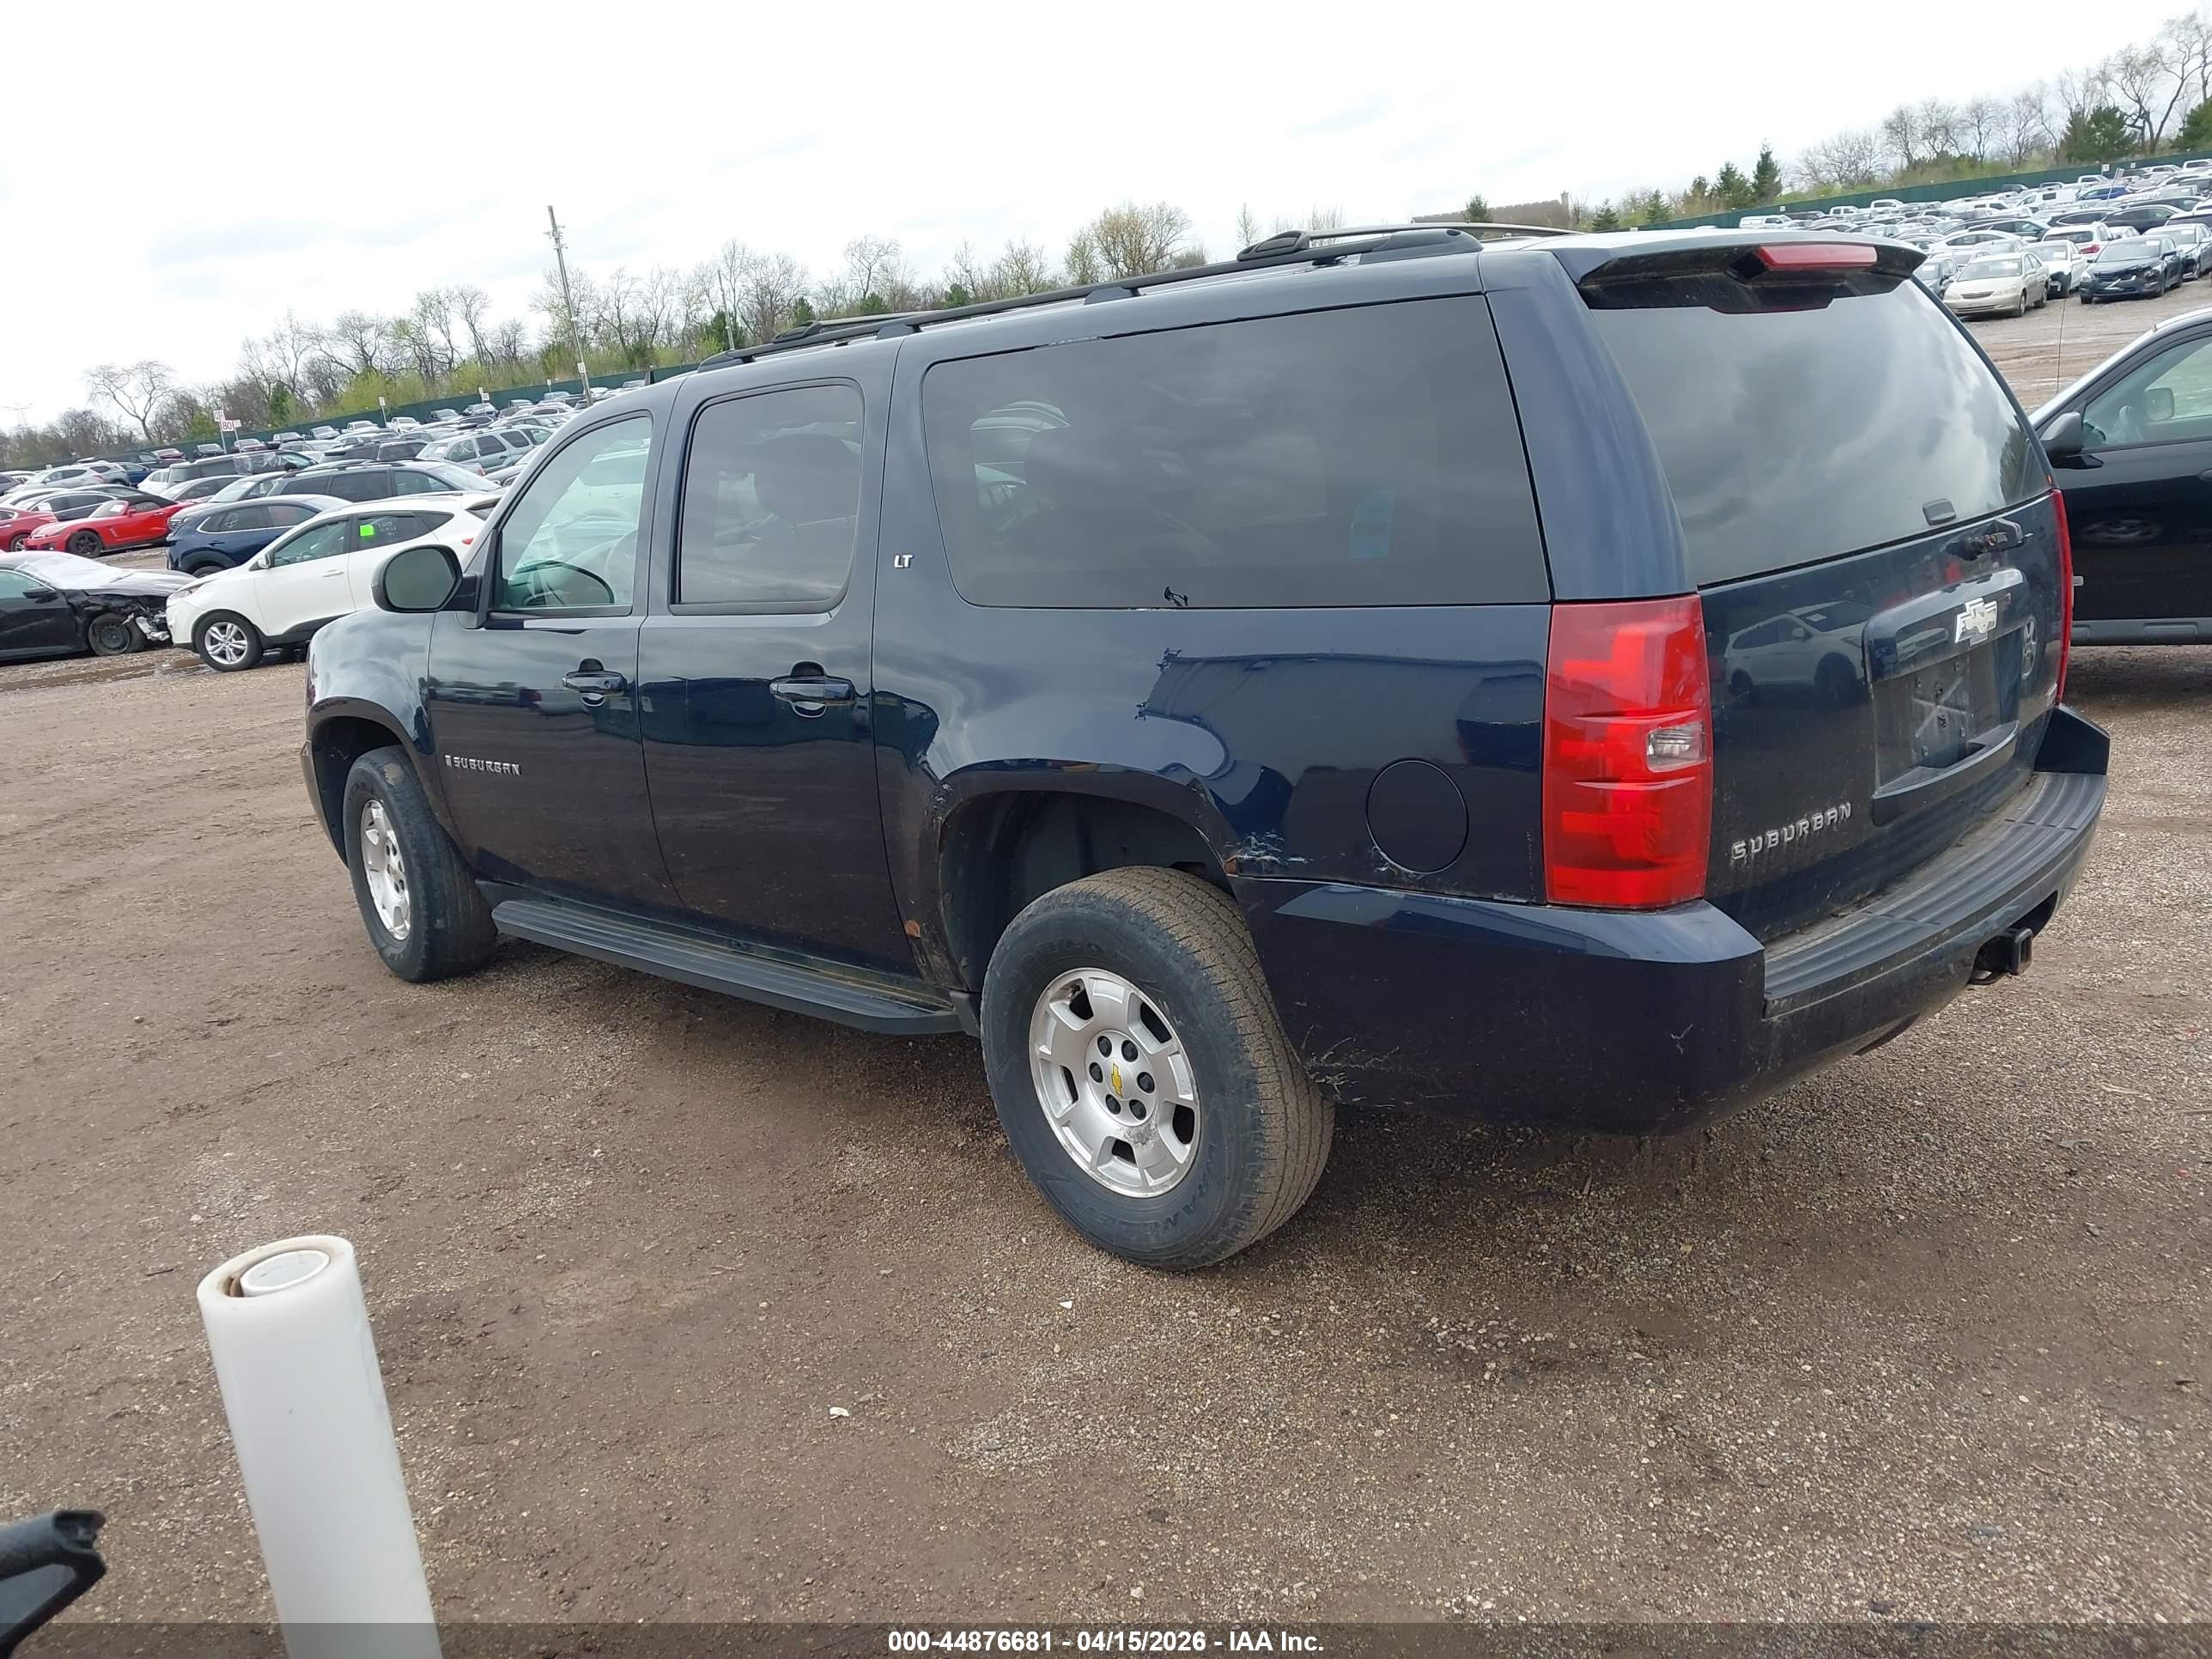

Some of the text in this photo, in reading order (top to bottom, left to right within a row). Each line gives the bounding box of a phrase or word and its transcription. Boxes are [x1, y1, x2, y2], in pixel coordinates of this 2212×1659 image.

[222, 421, 232, 430] 80
[894, 555, 914, 568] LT
[453, 757, 520, 776] SUBURBAN
[1731, 802, 1851, 860] SUBURBAN
